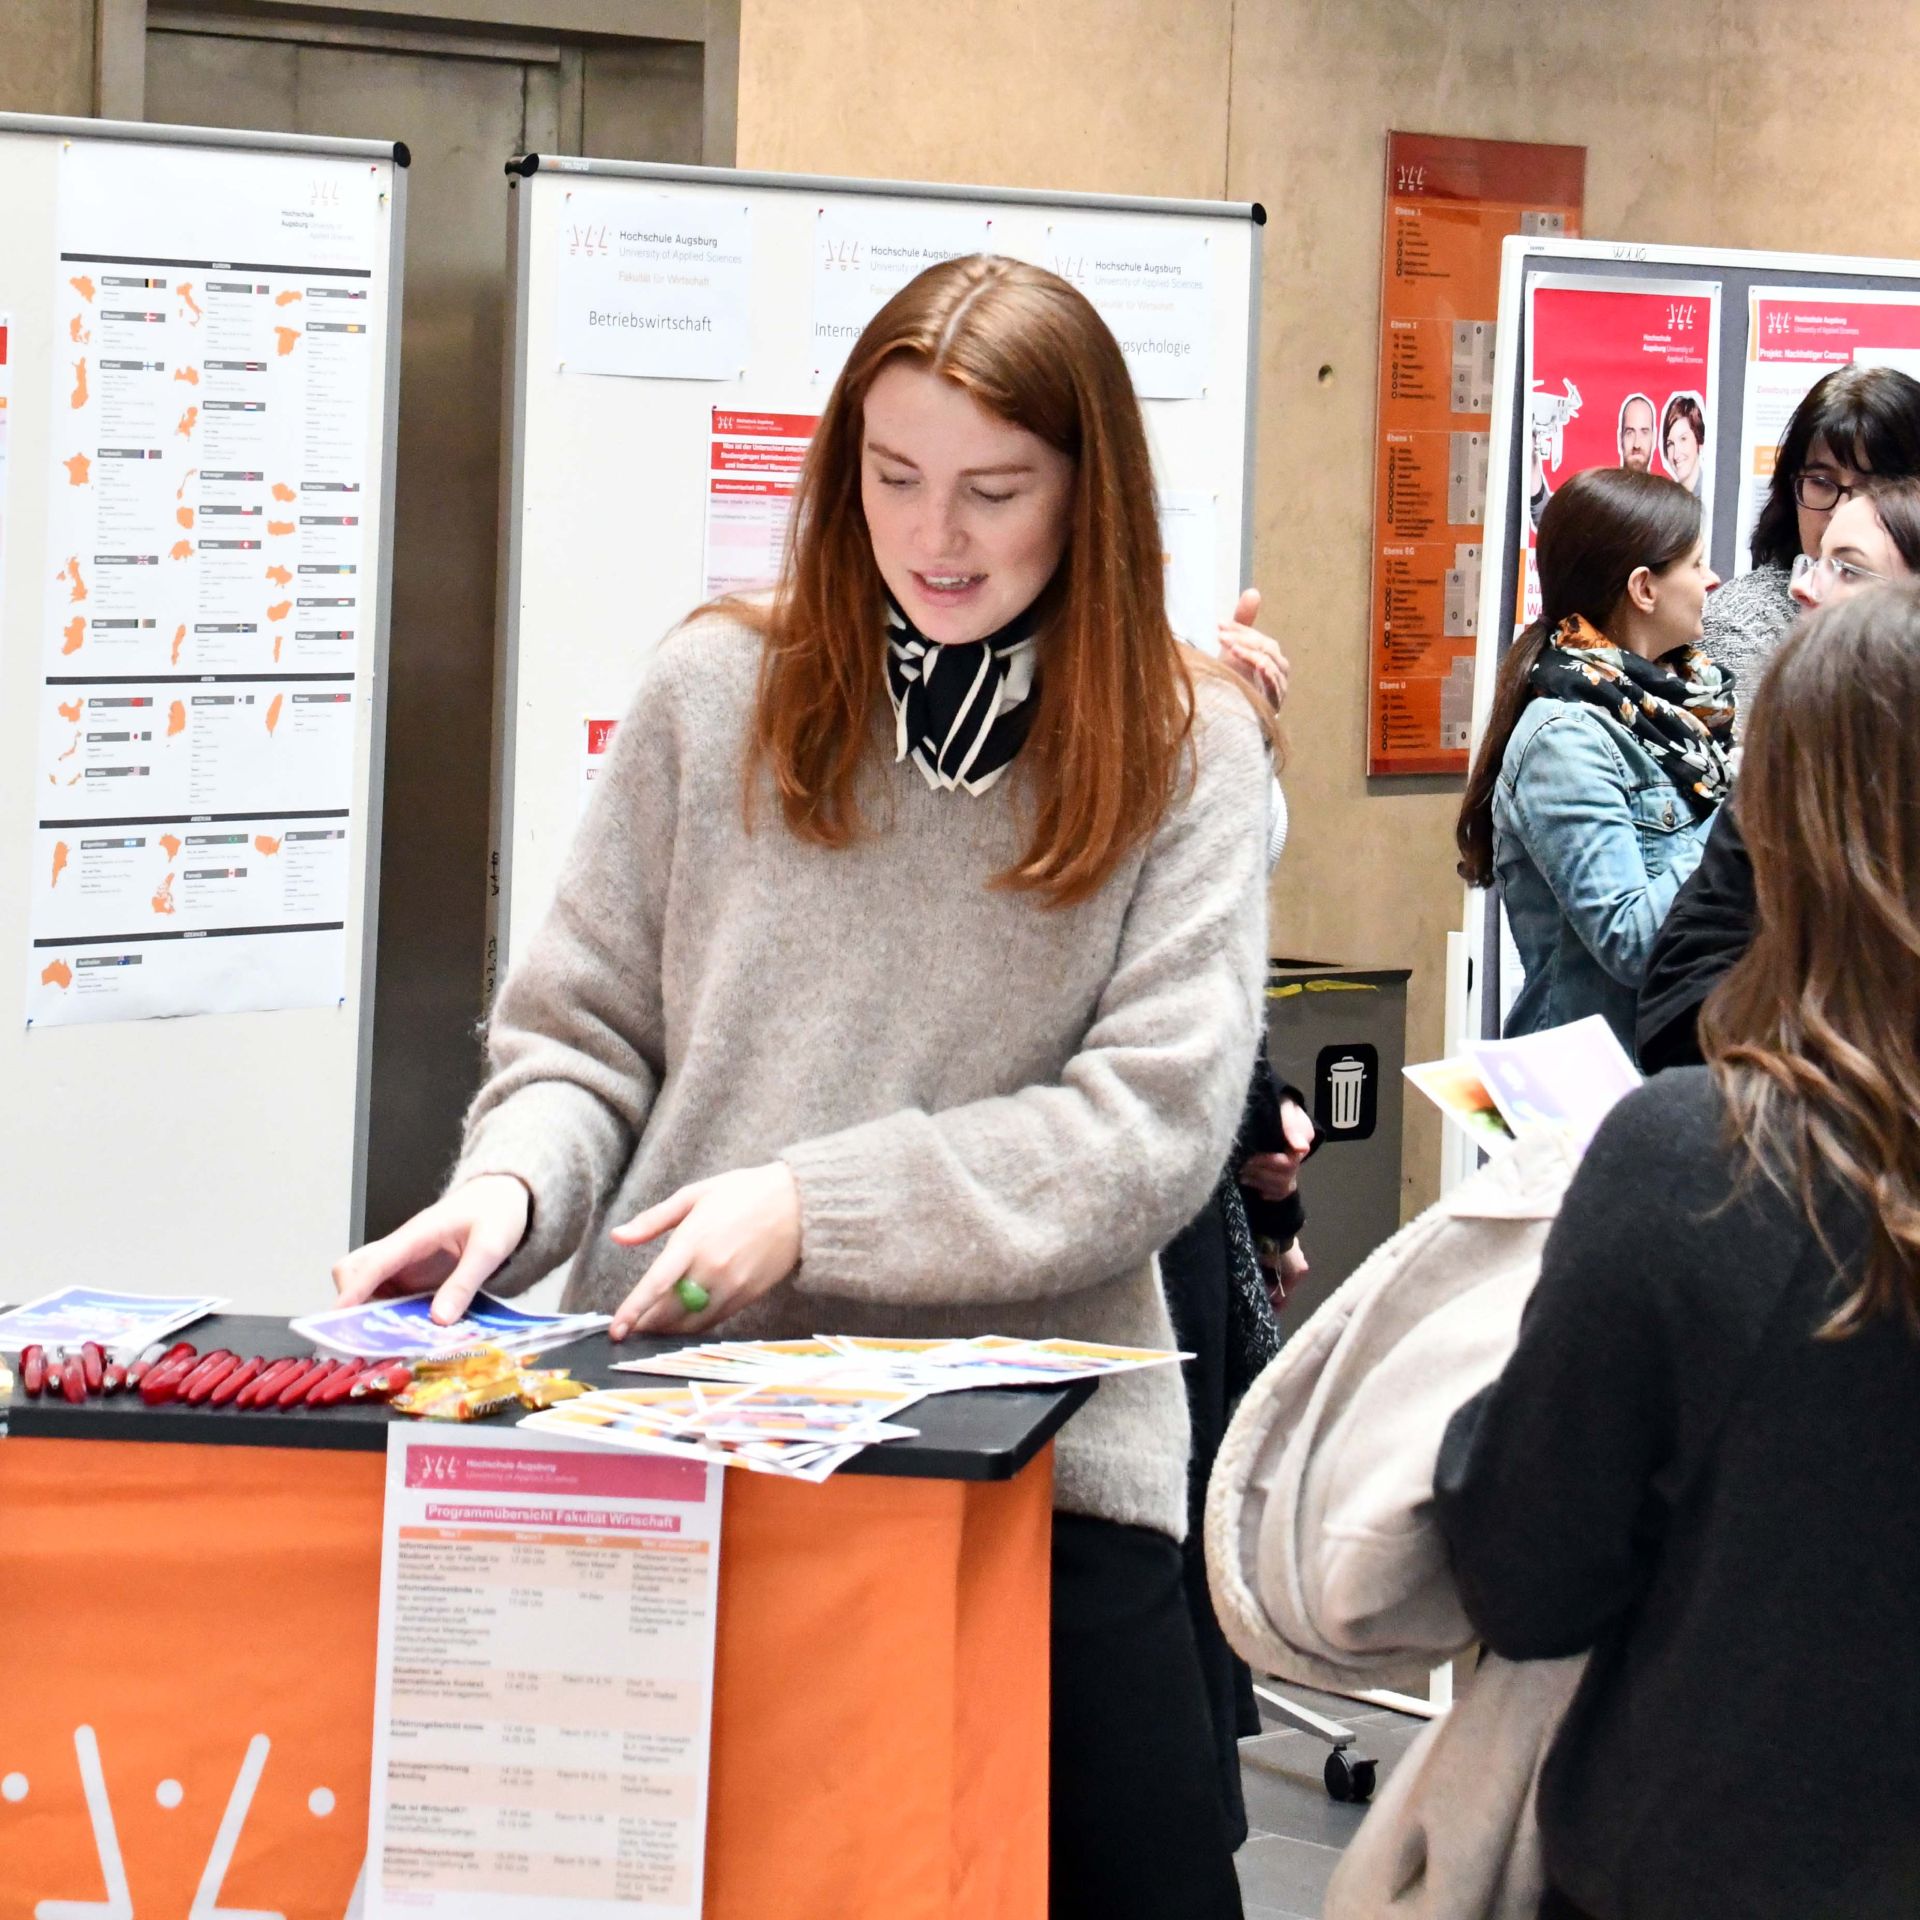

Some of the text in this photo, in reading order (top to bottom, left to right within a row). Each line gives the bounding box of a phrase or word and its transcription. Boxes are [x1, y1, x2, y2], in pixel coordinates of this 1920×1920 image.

[1395, 206, 1415, 216] Ebene
[619, 231, 718, 248] Hochschule Augsburg
[619, 247, 742, 265] University of Applied Sciences
[870, 246, 962, 260] Hochschule Augsbur
[870, 263, 909, 274] University
[1095, 260, 1182, 275] Hochschule Augsburg
[589, 311, 713, 332] Betriebswirtschaft
[1390, 320, 1411, 329] Ebene
[1386, 433, 1407, 442] Ebene
[1383, 546, 1403, 555] Ebene
[1379, 681, 1399, 690] Ebene
[466, 1459, 557, 1473] Hochschule Augsburg
[428, 1504, 673, 1529] Programmübersicht Fakultät Wirtschaft
